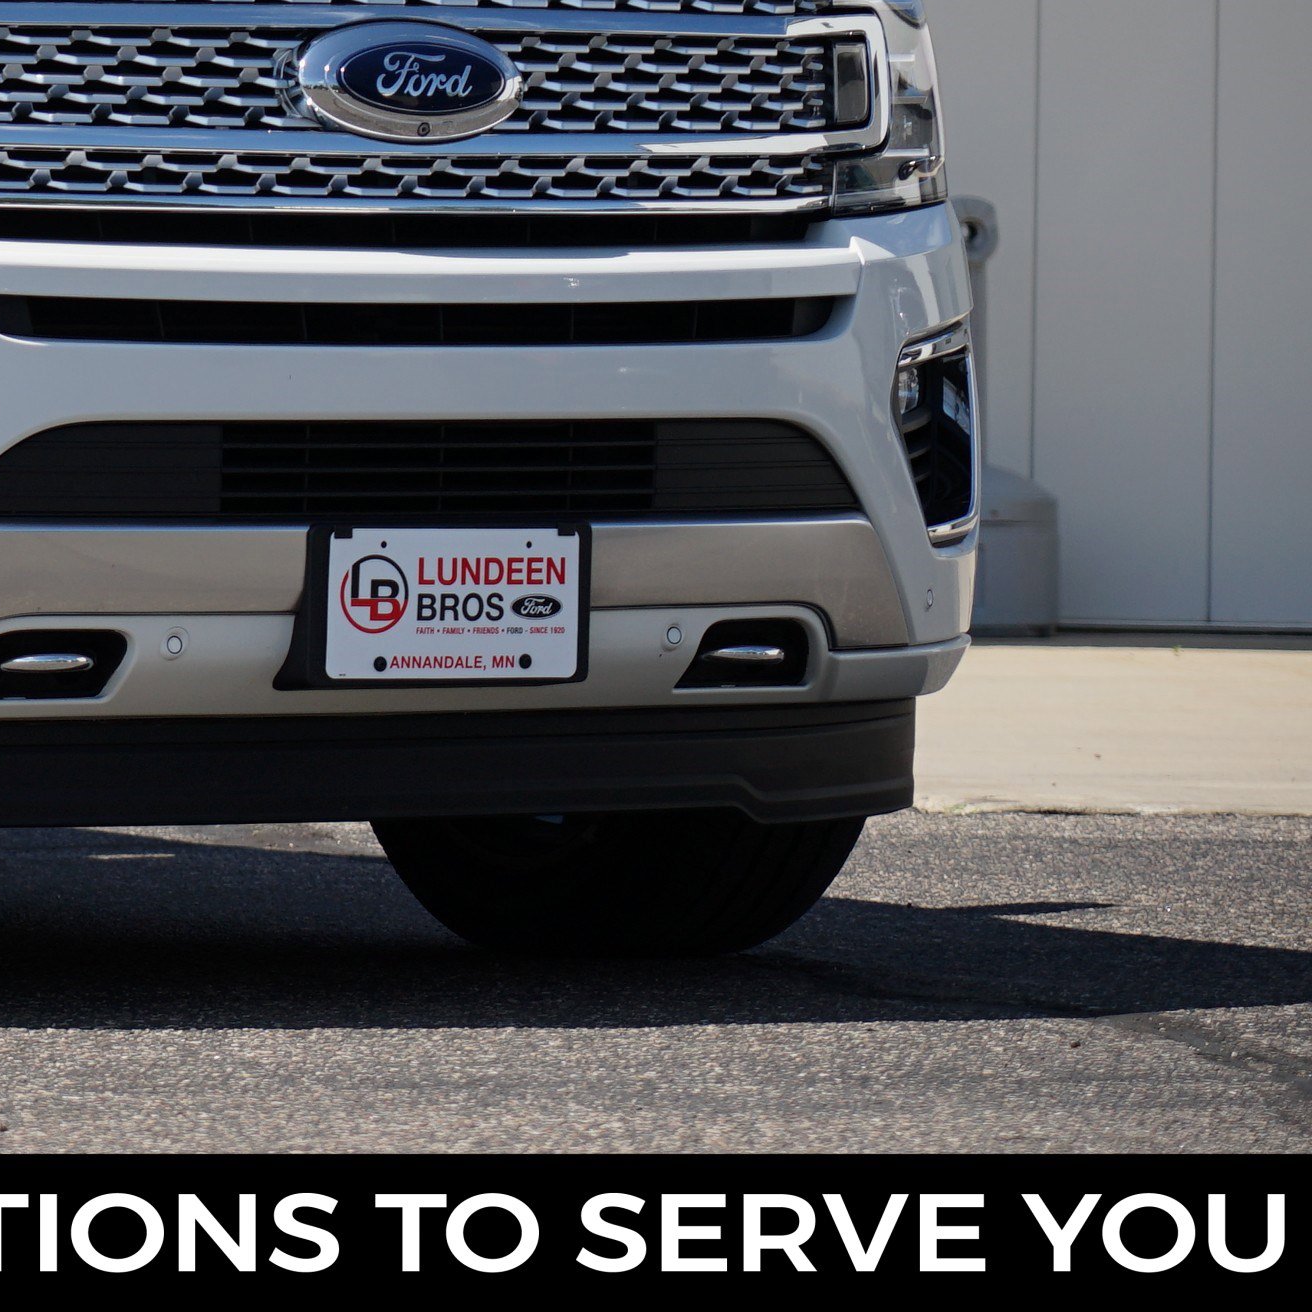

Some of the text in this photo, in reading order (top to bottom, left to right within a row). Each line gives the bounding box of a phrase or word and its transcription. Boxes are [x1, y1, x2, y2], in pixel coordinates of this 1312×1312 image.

[376, 50, 473, 98] Ford
[418, 557, 566, 585] LUNDEEN
[416, 592, 504, 622] BROS
[520, 595, 553, 616] Ford
[415, 626, 566, 635] FAITH FAMILY FRIENDS FORD SINCE 1920
[389, 654, 515, 671] ANNANDALE, MN
